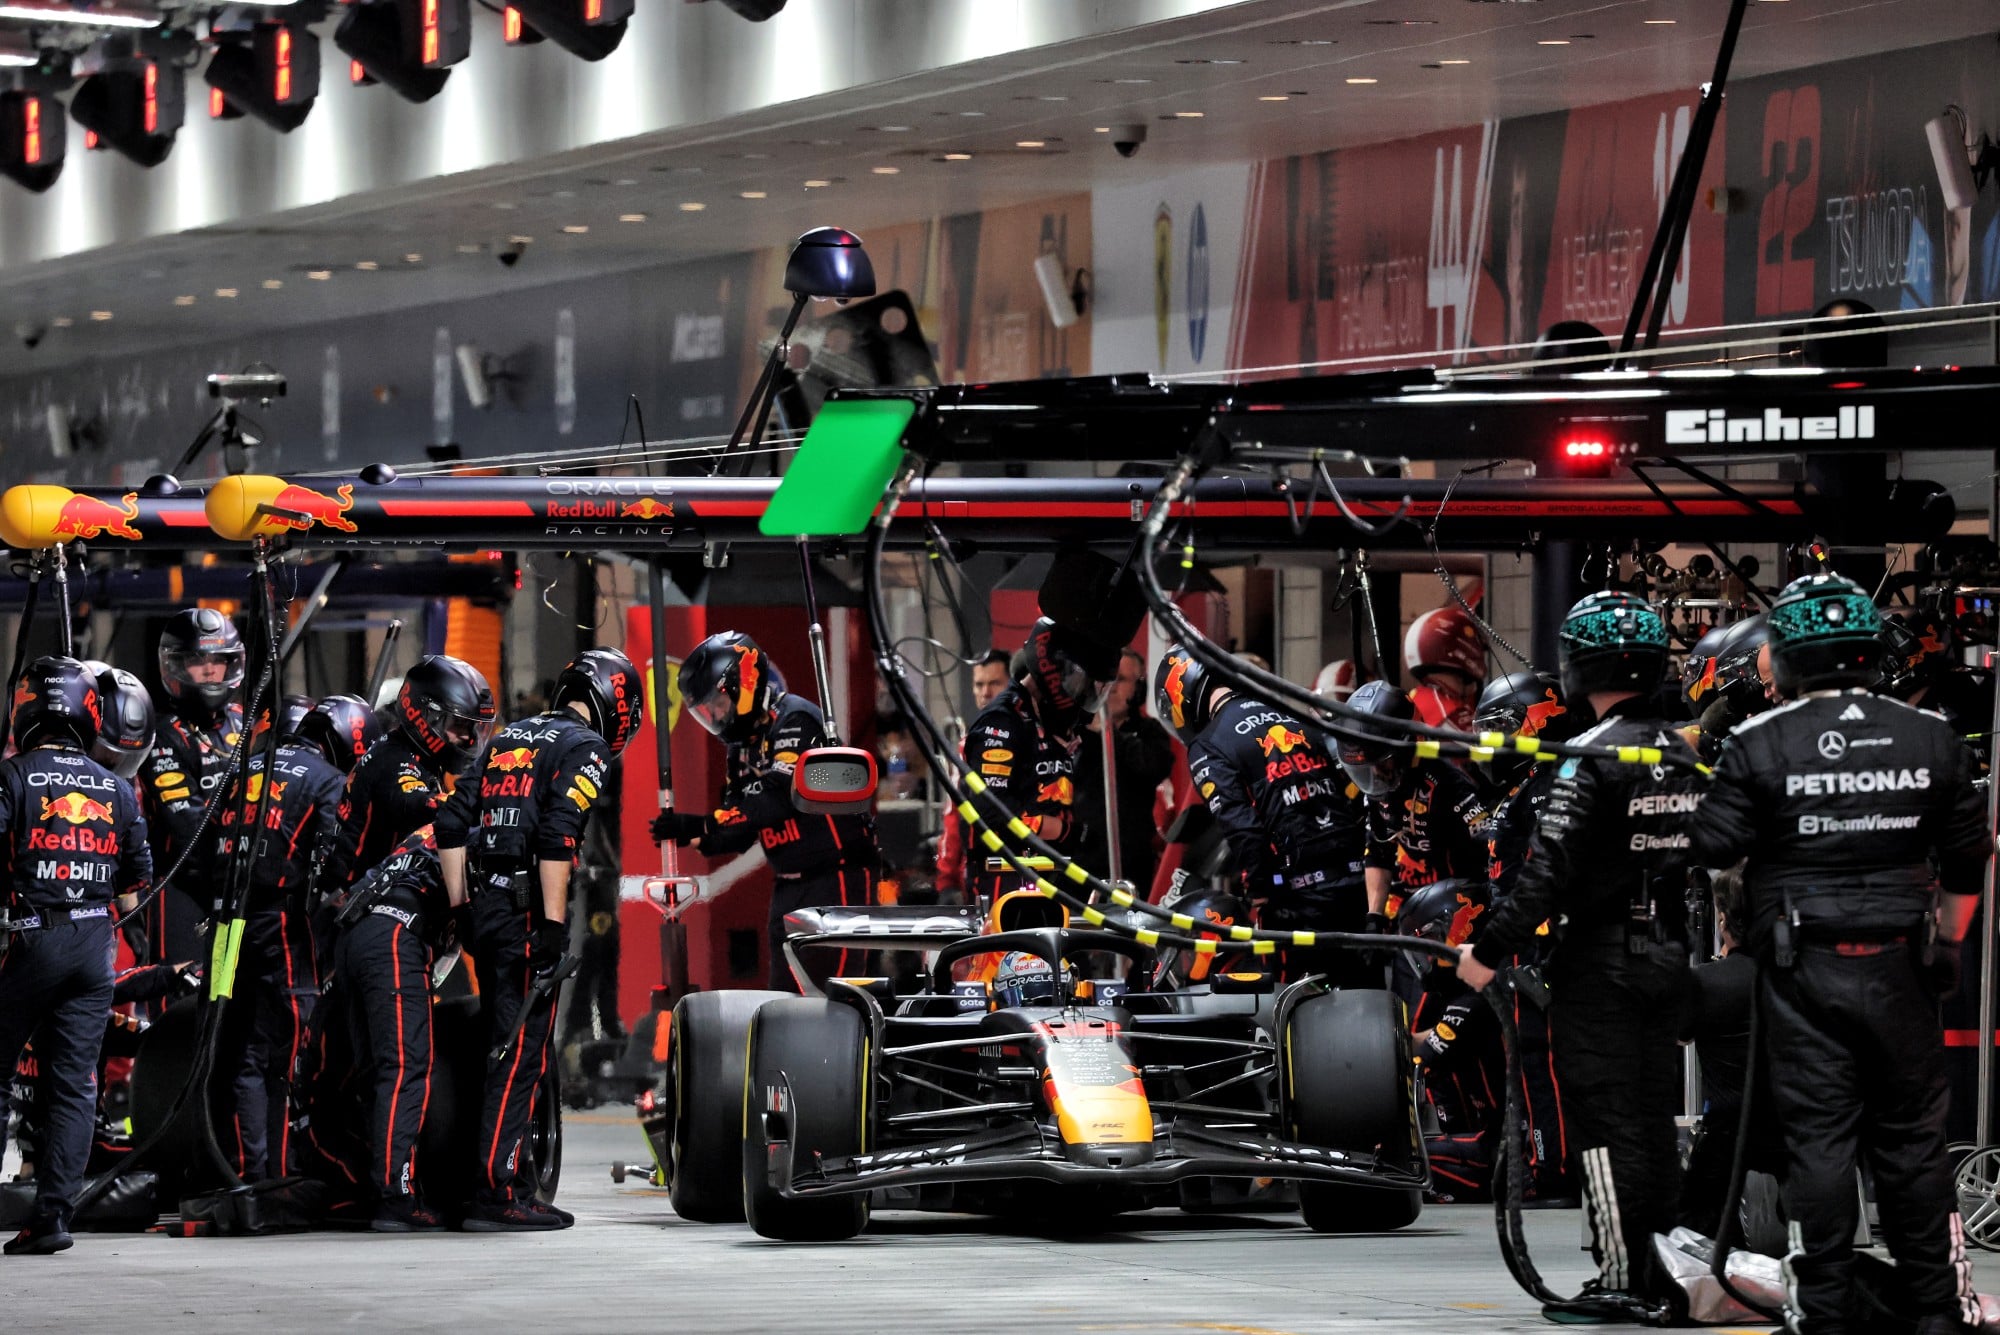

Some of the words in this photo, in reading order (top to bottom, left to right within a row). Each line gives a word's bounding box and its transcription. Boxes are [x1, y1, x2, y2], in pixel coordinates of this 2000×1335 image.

[1826, 184, 1931, 293] TSUNODA
[1665, 405, 1875, 444] Einhell
[546, 481, 674, 496] ORACLE
[546, 500, 581, 517] Red
[583, 500, 616, 517] Bull
[545, 526, 673, 536] RACING
[609, 672, 630, 716] Red
[27, 772, 117, 792] ORACLE
[1786, 768, 1931, 796] PETRONAS
[1627, 793, 1706, 817] PETRON
[1821, 813, 1921, 832] TeamViewer
[28, 826, 78, 851] Red
[79, 827, 119, 855] Bull
[761, 818, 801, 849] Bull
[36, 860, 95, 881] Mobil
[1009, 974, 1054, 988] ORACLE
[959, 998, 985, 1007] Gate
[1098, 998, 1113, 1007] Ga
[766, 1085, 788, 1113] Mobil
